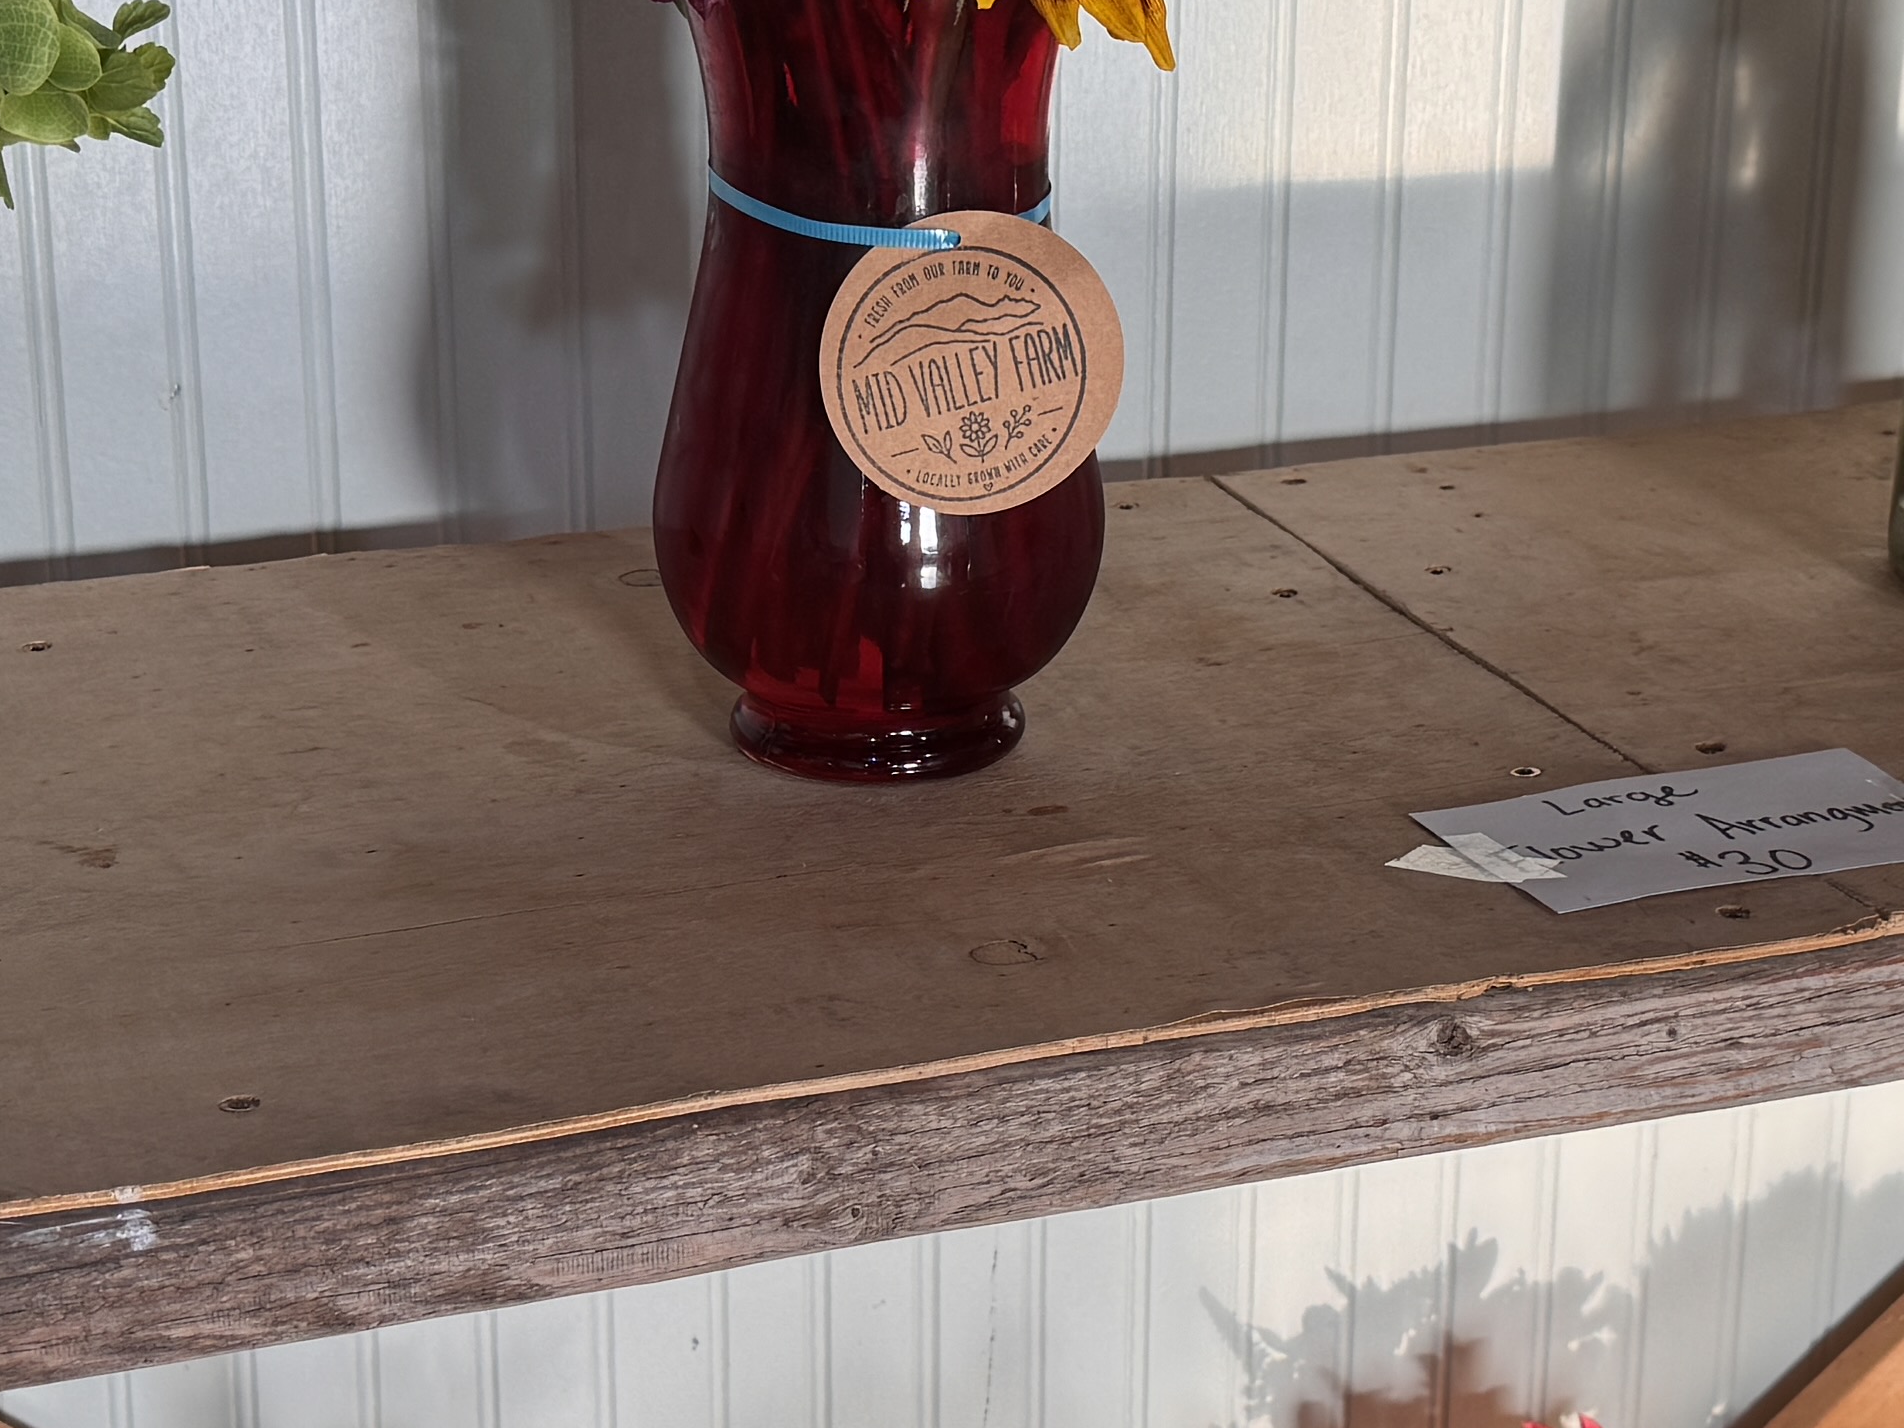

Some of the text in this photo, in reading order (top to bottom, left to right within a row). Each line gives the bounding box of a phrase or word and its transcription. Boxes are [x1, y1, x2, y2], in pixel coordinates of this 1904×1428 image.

[864, 260, 1026, 328] FRESH FROM OUR FARM TO YOU
[852, 323, 1079, 434] MID VALLEY FARM
[916, 434, 1054, 488] LOCALLY GROWN WITH CARE
[1541, 782, 1700, 817] Large
